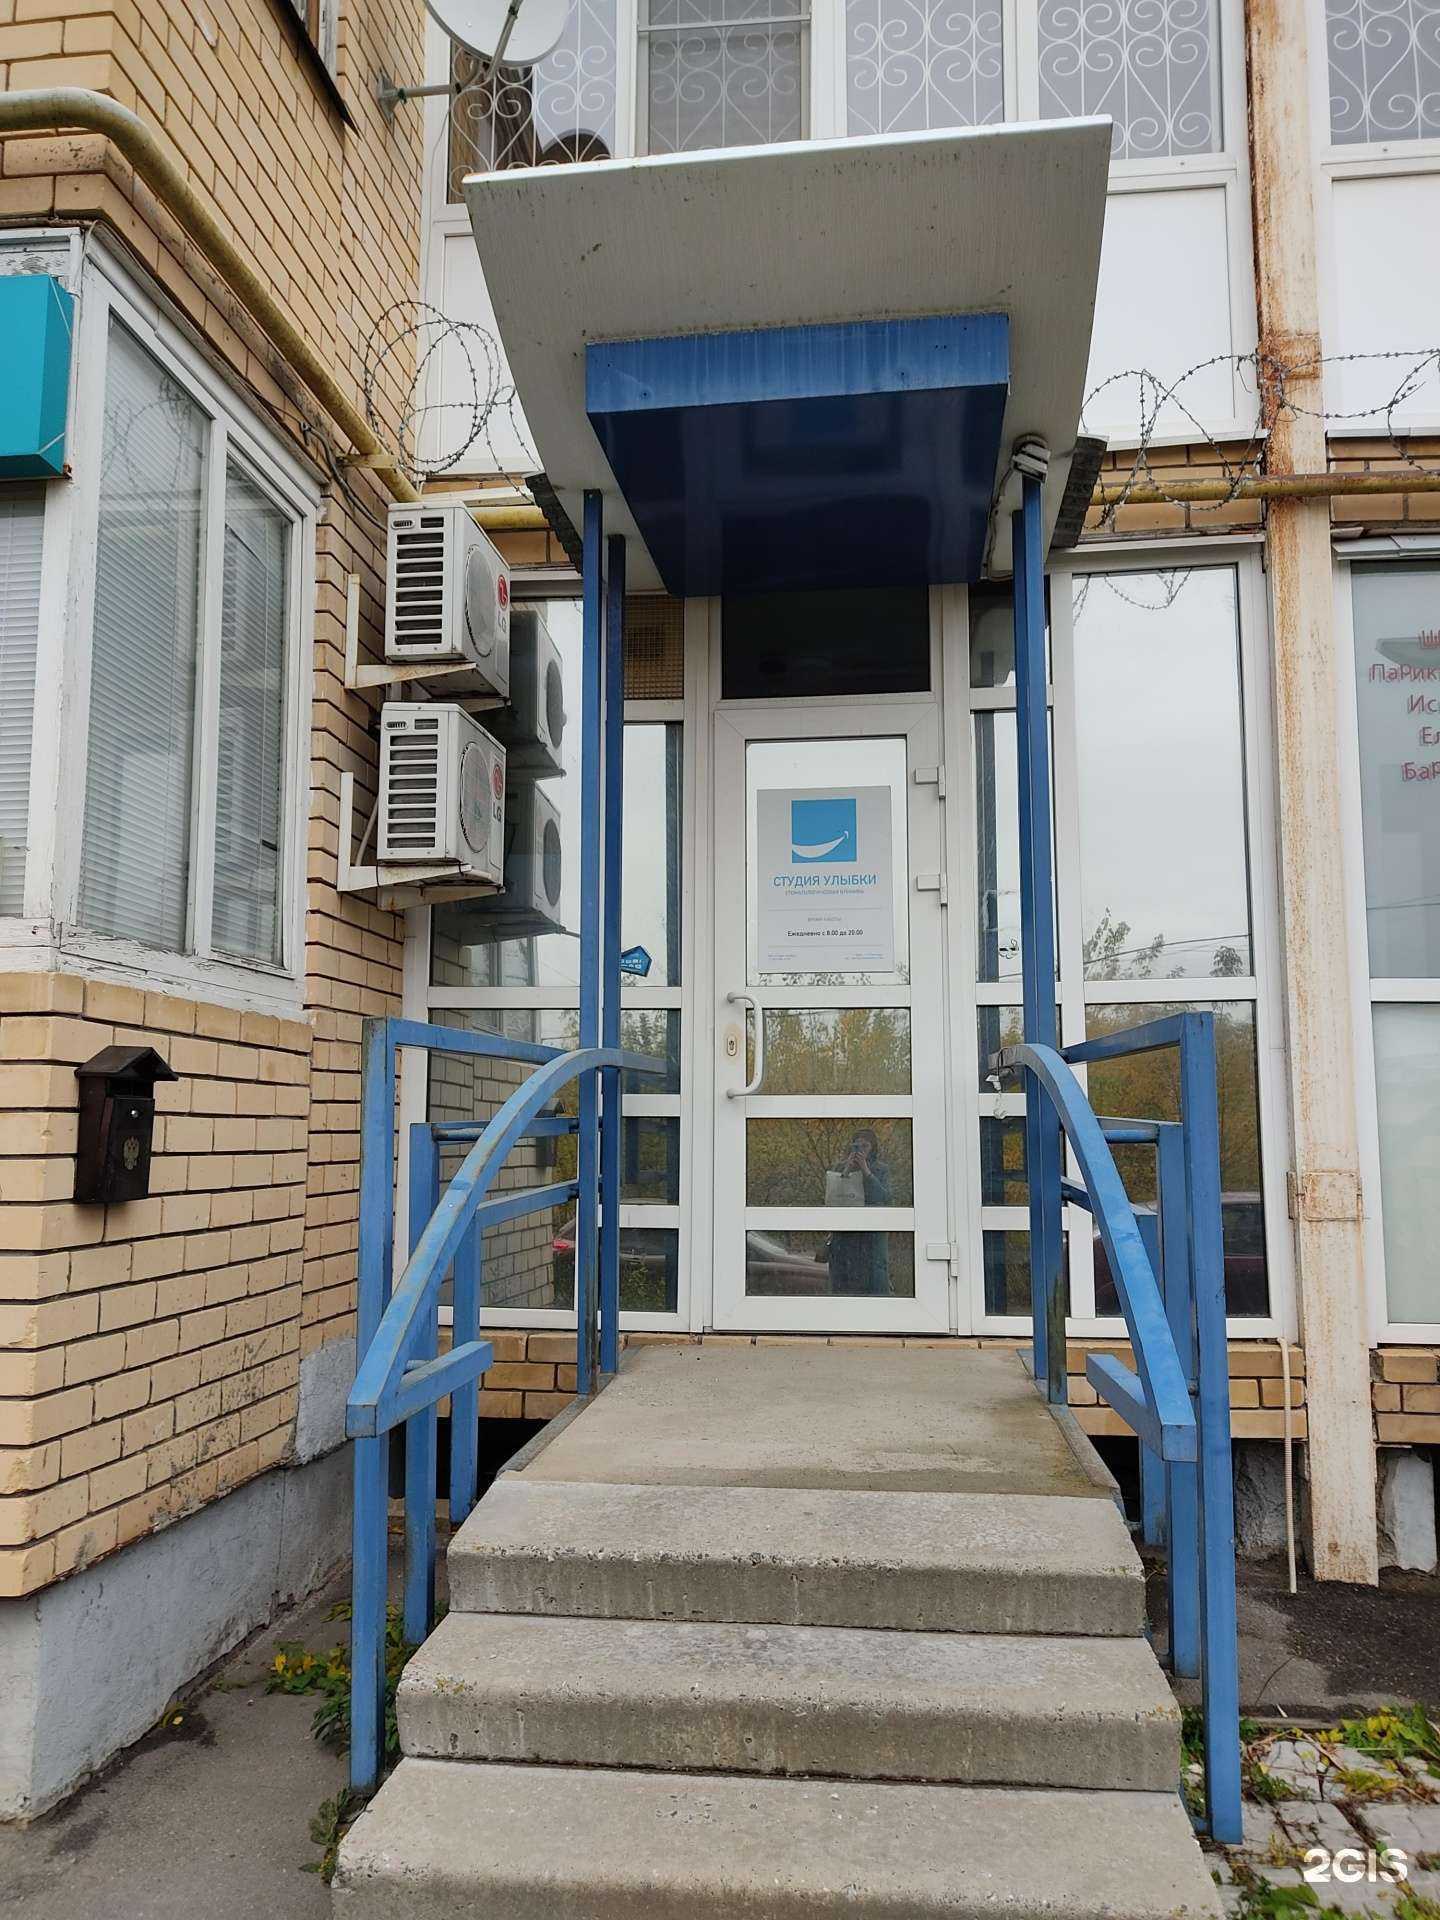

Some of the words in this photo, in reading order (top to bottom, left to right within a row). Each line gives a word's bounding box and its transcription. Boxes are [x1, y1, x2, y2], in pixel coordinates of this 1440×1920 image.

[498, 611, 507, 634] LG
[493, 802, 502, 823] LG
[773, 875, 820, 889] СТУДИЯ
[823, 874, 877, 886] УЛЫБКИ
